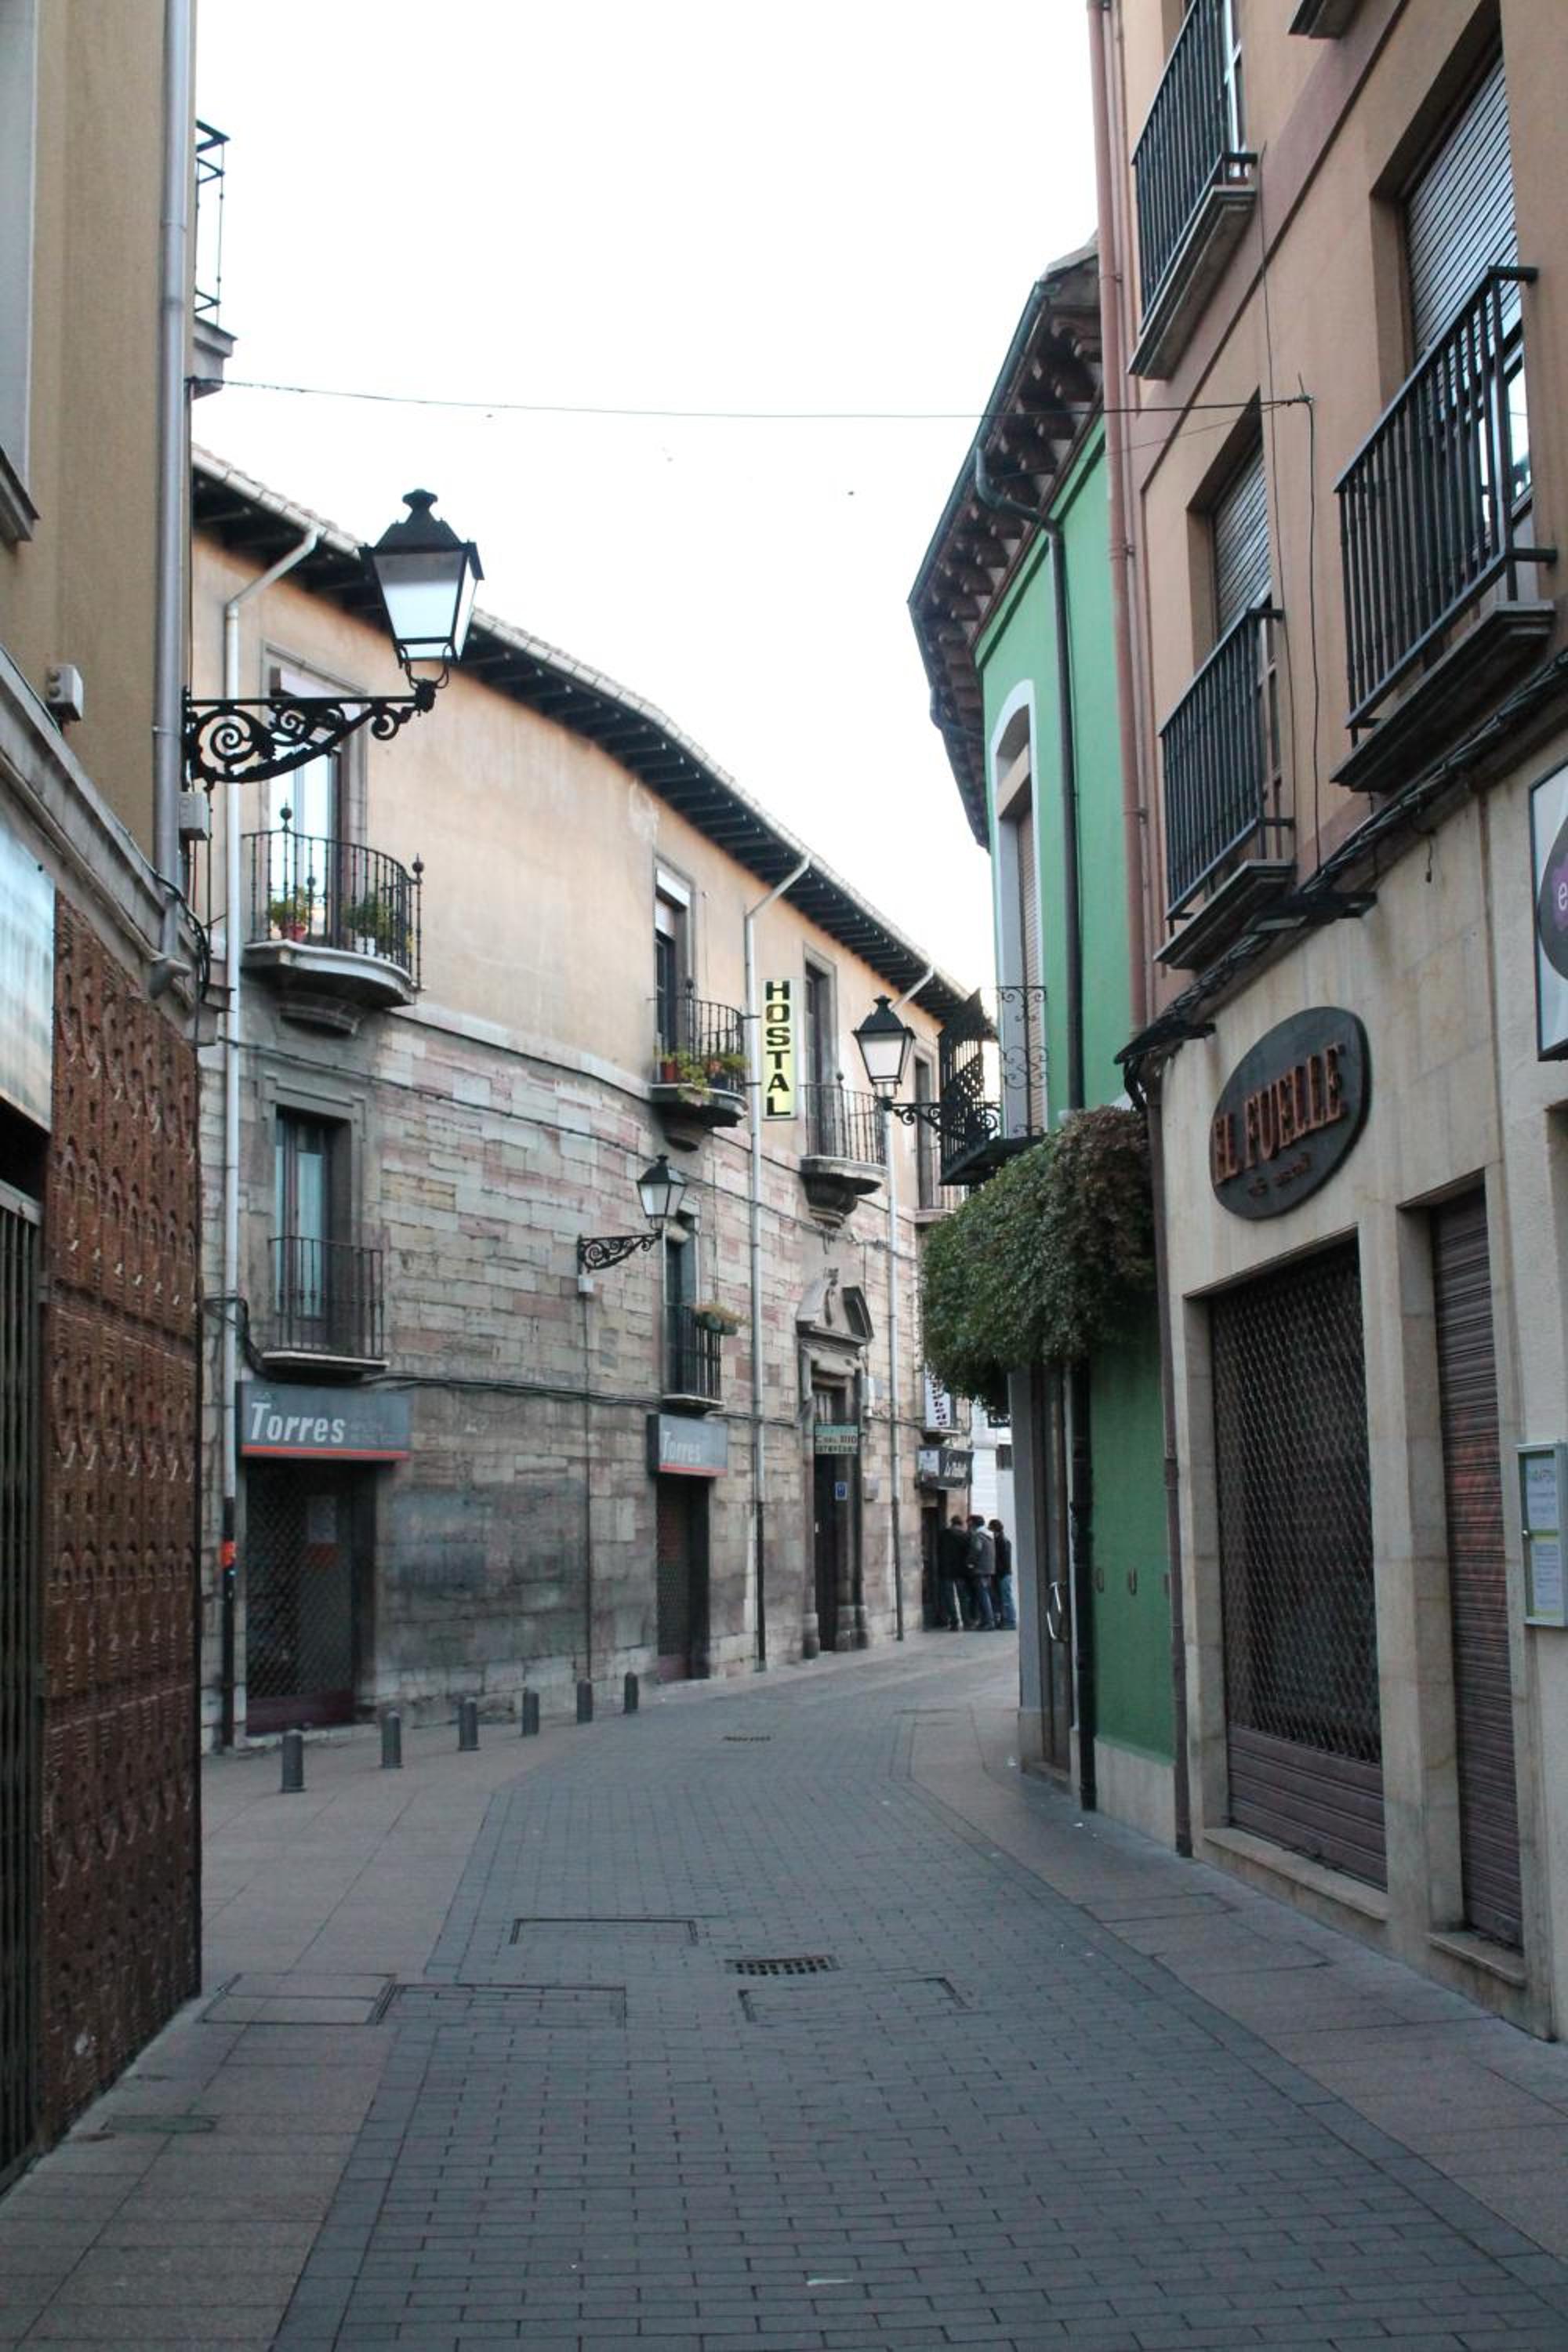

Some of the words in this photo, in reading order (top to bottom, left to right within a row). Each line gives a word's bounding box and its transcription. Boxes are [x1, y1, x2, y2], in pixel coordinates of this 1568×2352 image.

[766, 981, 790, 1116] HOSTAL
[1214, 1114, 1238, 1186] EL
[1246, 1043, 1344, 1167] FUELLE
[250, 1402, 347, 1444] Torres
[662, 1430, 702, 1463] Torres
